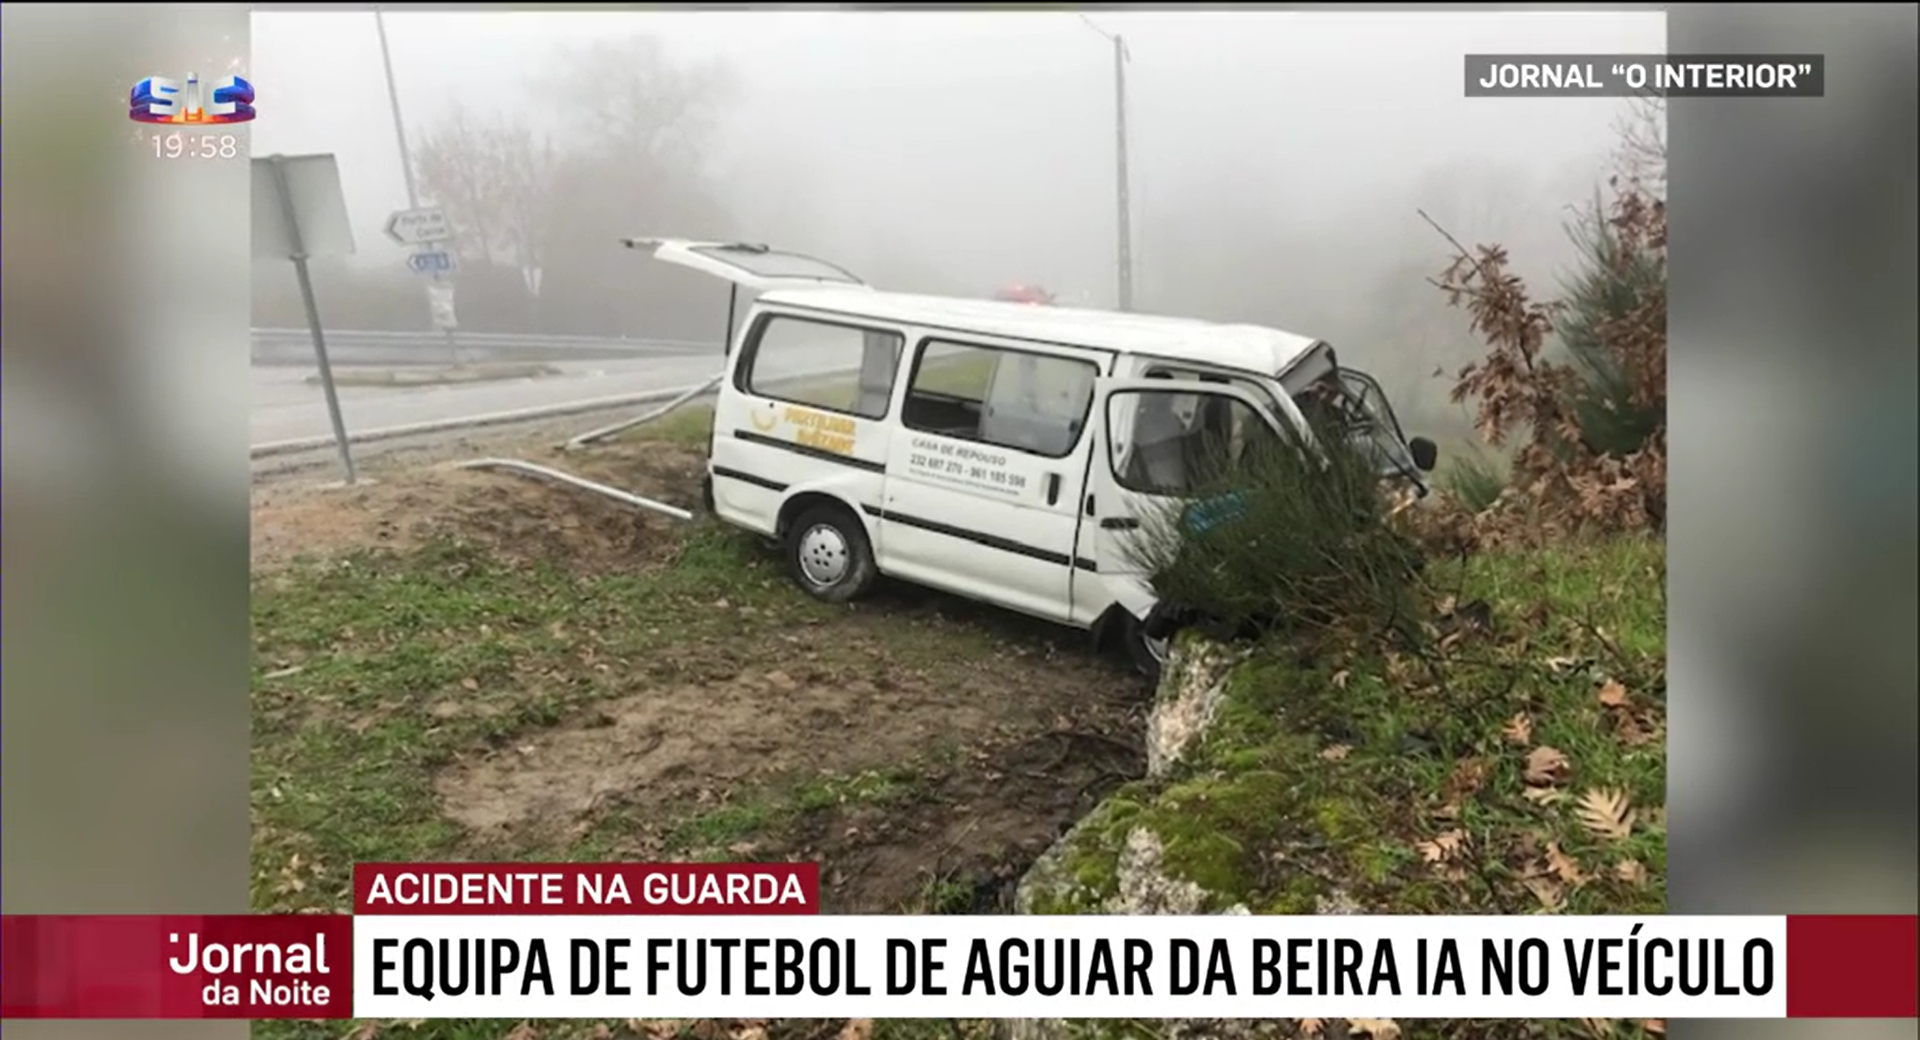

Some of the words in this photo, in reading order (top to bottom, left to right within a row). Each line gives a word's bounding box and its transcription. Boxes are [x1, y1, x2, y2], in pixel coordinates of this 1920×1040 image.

[911, 437, 938, 451] CASA
[940, 444, 954, 456] DE
[956, 447, 1007, 467] REPOUSO
